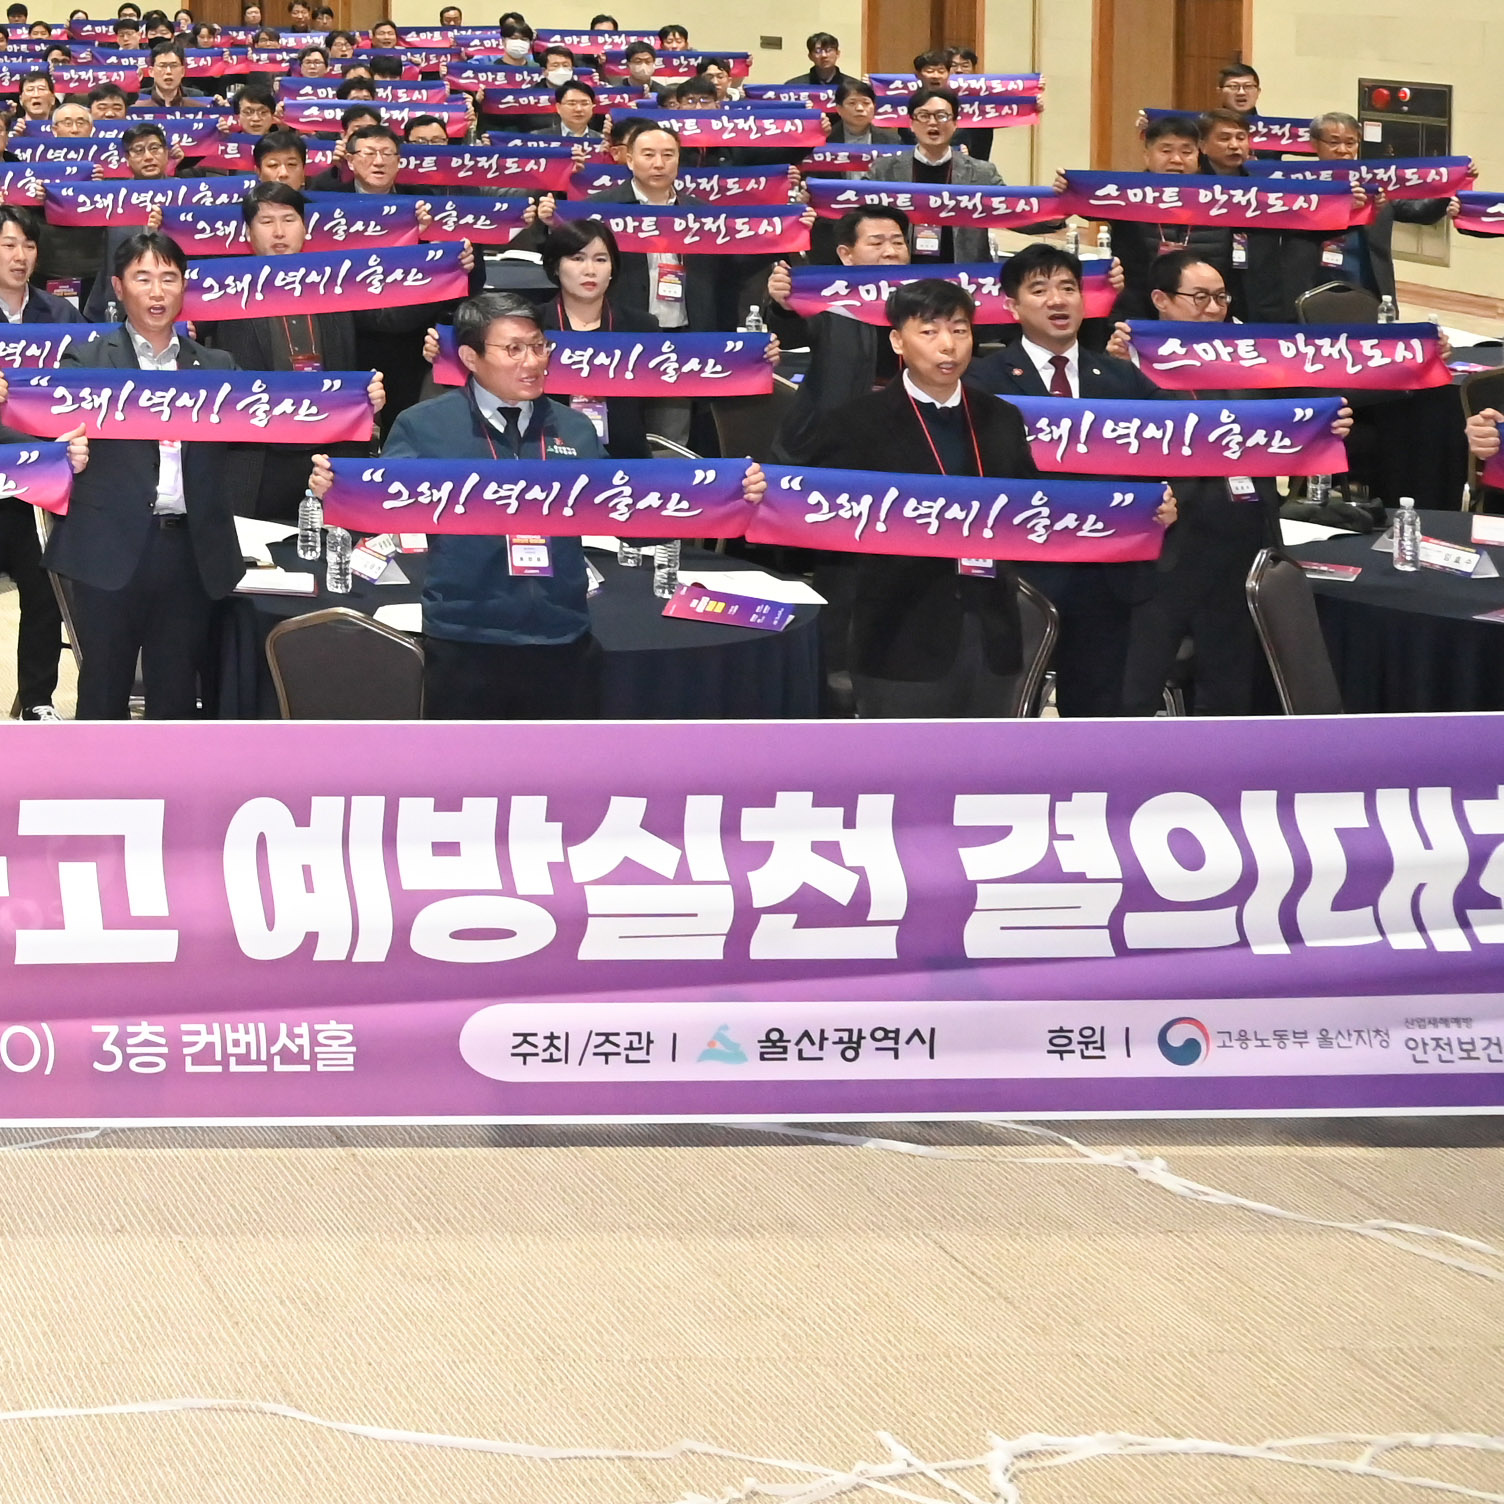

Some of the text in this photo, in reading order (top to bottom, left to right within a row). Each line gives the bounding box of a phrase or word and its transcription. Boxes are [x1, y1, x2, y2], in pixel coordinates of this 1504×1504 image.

[710, 115, 803, 140] 안전도시
[451, 153, 546, 179] 안전도시
[1348, 164, 1448, 192] 안전도시
[61, 187, 128, 219] “그래!
[929, 191, 1039, 218] 안전도시
[1089, 184, 1319, 218] 스마트 안전도시
[323, 205, 397, 241] 울산”
[673, 213, 782, 245] 안전도시
[274, 249, 444, 297] 역시! 울산”
[560, 340, 744, 383] 역시! 울산”
[1153, 333, 1423, 374] 스마트 안전도시
[30, 375, 342, 432] “그래! 역시! 울산”
[1102, 407, 1314, 460] 역시! 울산”
[362, 468, 716, 524] “그래! 역시! 울산”
[780, 475, 1134, 544] “그래! 역시! 울산”
[223, 790, 908, 965] 예방실천
[91, 1020, 169, 1074] 3층
[180, 1019, 357, 1073] 컨벤션홀
[757, 1025, 936, 1063] 울산광역시
[1046, 1025, 1391, 1061] 후원 고용노동부 울산지청
[1405, 1036, 1504, 1064] 안전보건
